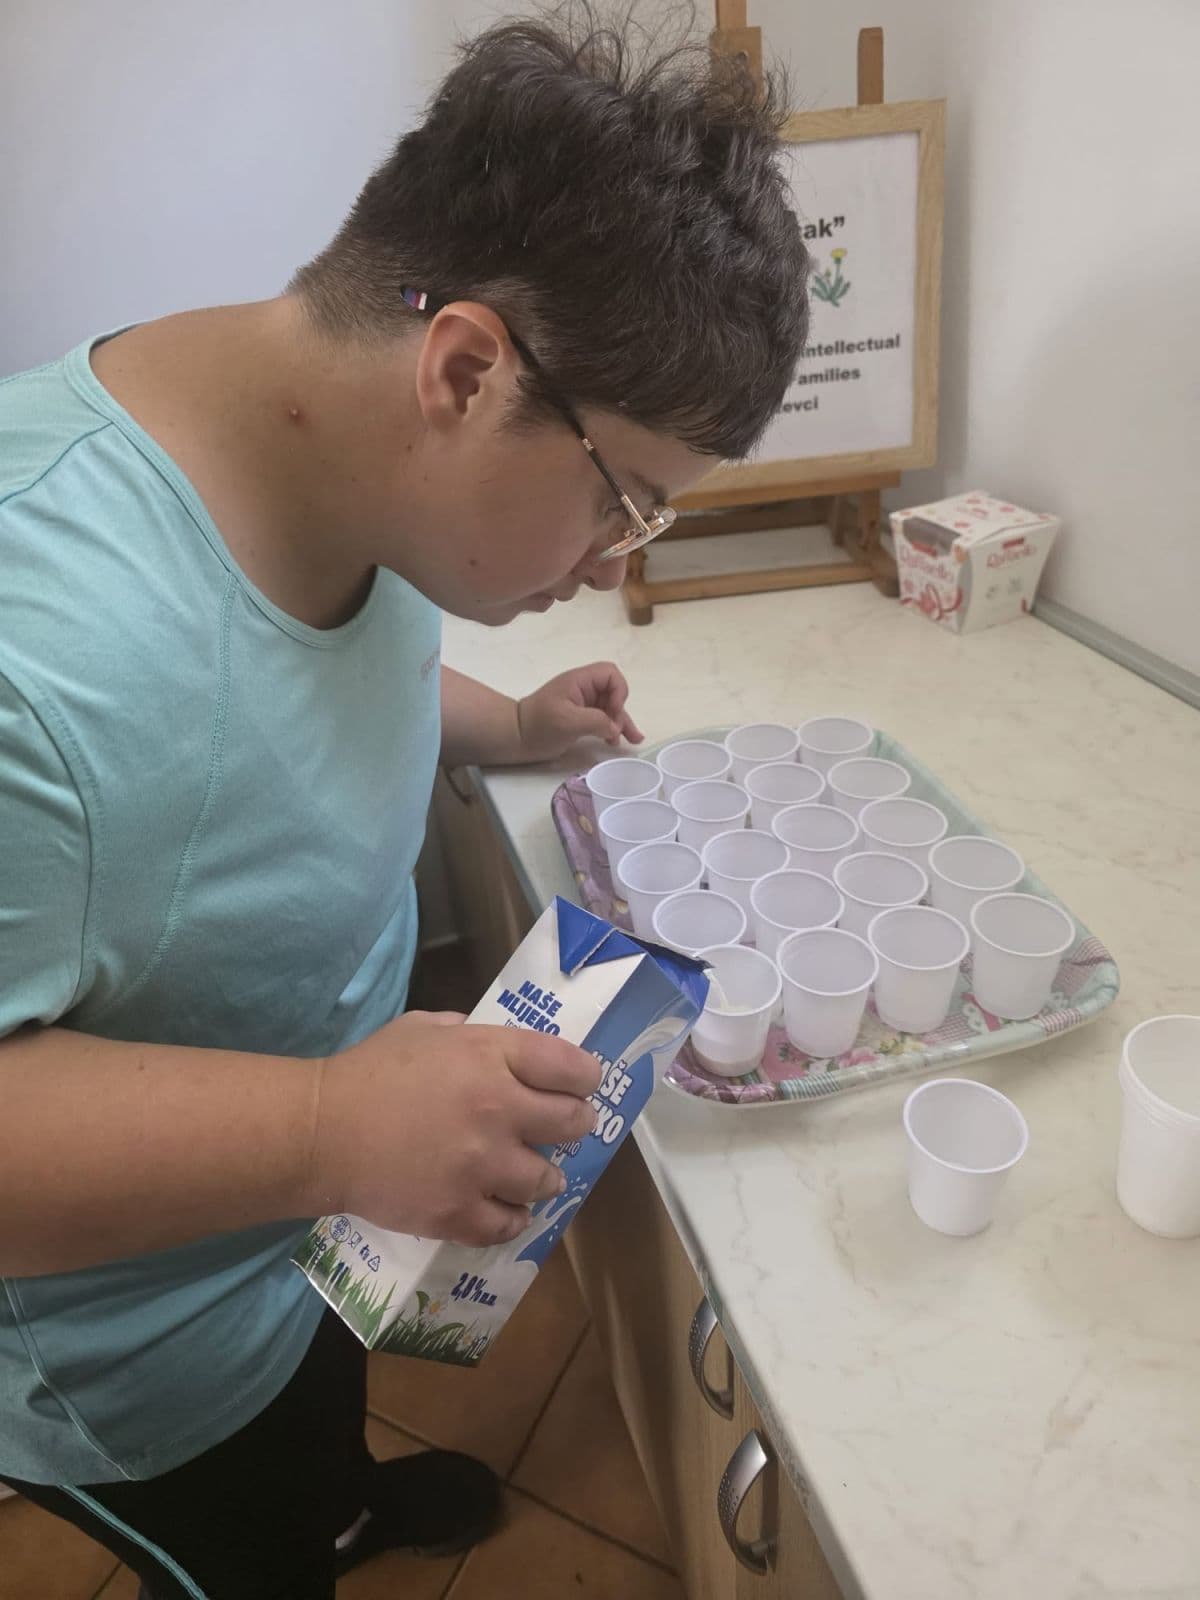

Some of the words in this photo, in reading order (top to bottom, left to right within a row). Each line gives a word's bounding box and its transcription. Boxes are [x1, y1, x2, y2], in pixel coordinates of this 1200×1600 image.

[803, 216, 846, 240] ak”
[800, 333, 901, 358] intellectual
[798, 367, 861, 386] amilies
[782, 395, 819, 413] evci
[518, 980, 563, 1018] NAŠE
[496, 988, 561, 1037] MLIJEKO
